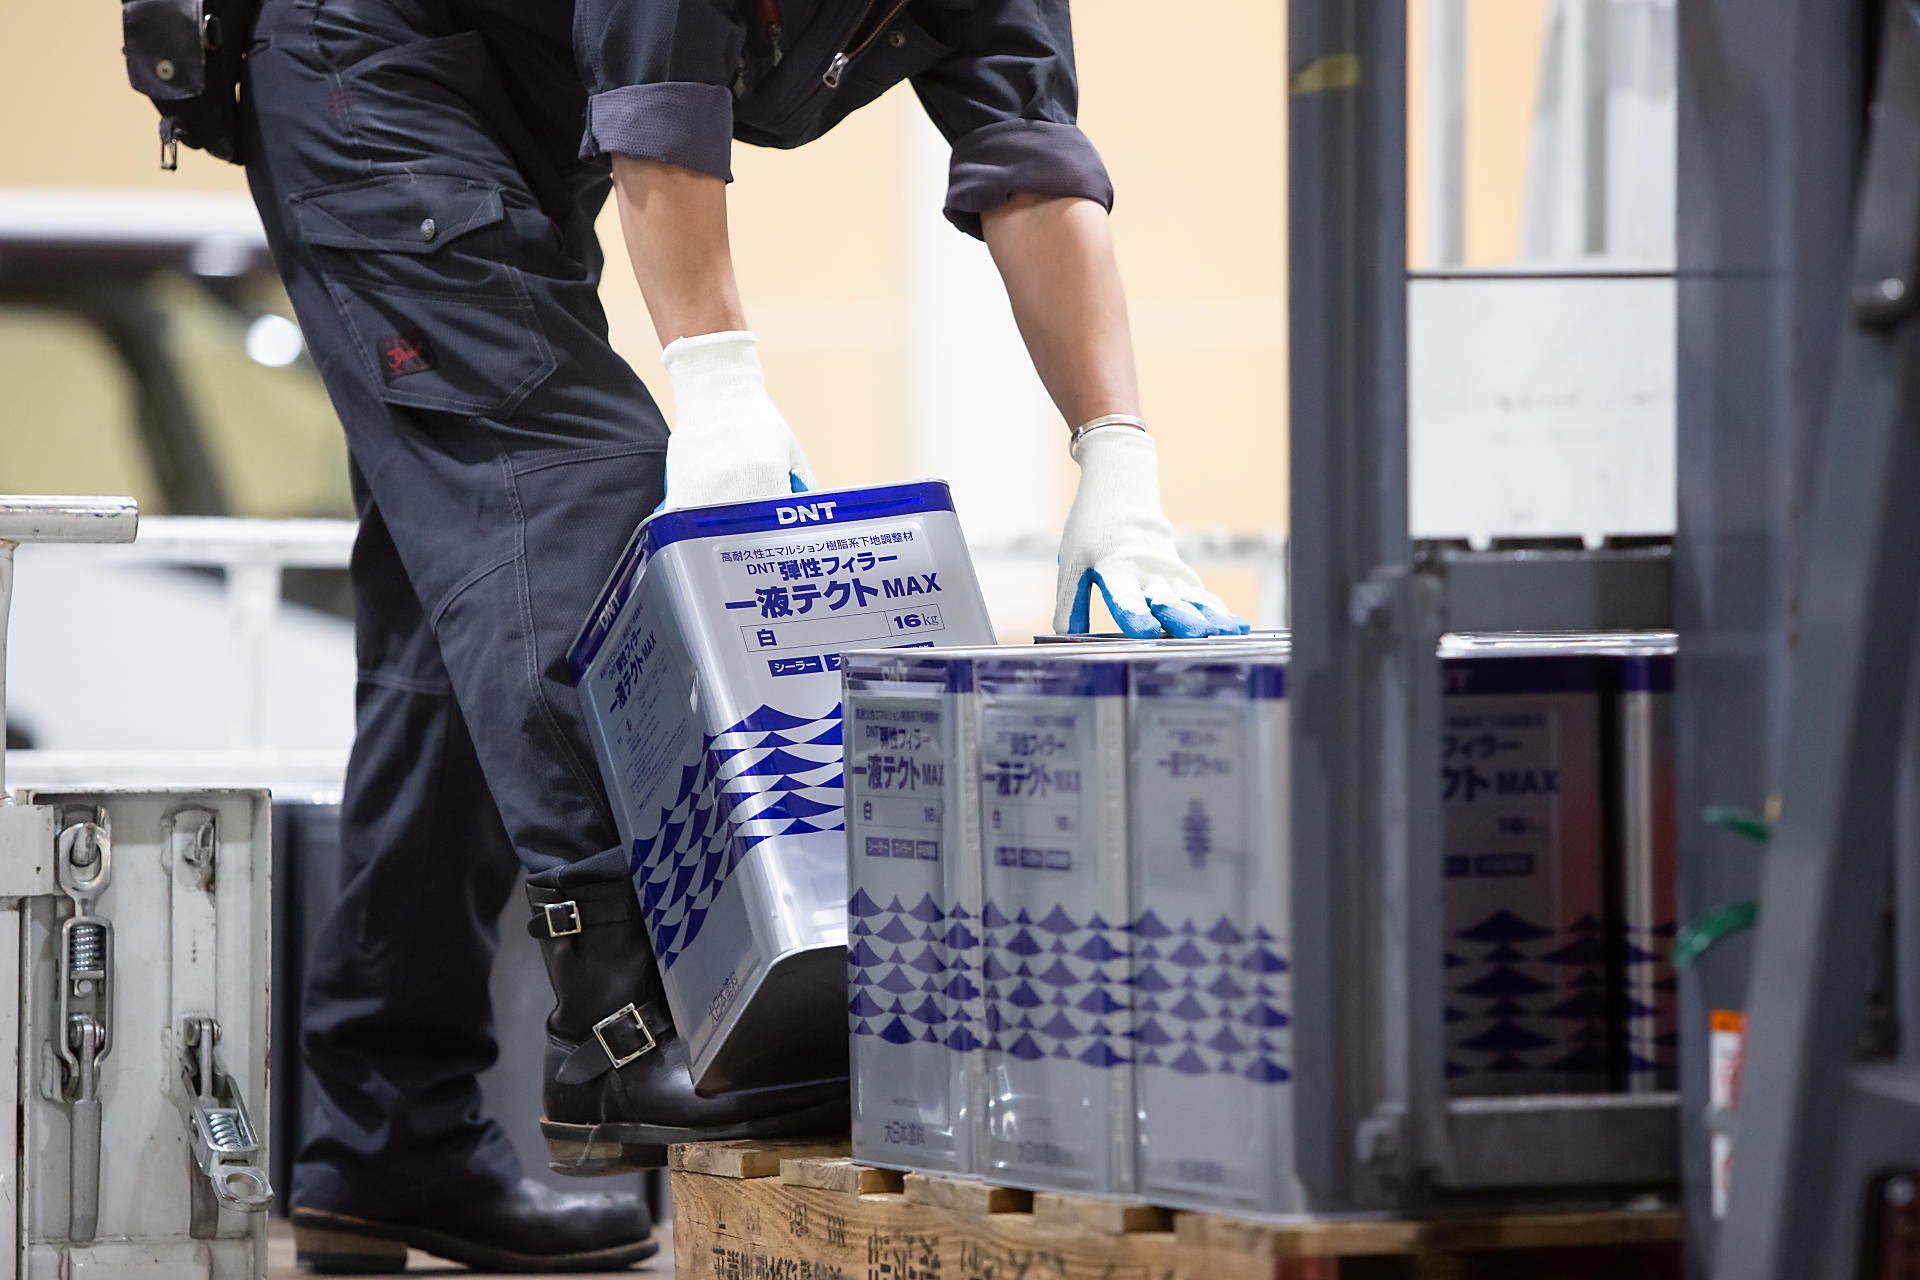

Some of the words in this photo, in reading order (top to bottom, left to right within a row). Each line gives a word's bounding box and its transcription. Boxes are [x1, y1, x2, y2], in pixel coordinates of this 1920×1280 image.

[776, 501, 837, 525] DNT
[720, 531, 914, 562] 高耐久性エマルション樹脂系下地調整材
[747, 562, 776, 576] DNT
[777, 552, 898, 581] 弾性フィラー
[599, 588, 620, 632] DNT
[725, 578, 878, 619] 一液テクト
[882, 573, 942, 599] MAX
[757, 629, 777, 647] 白
[775, 661, 816, 672] シーラー
